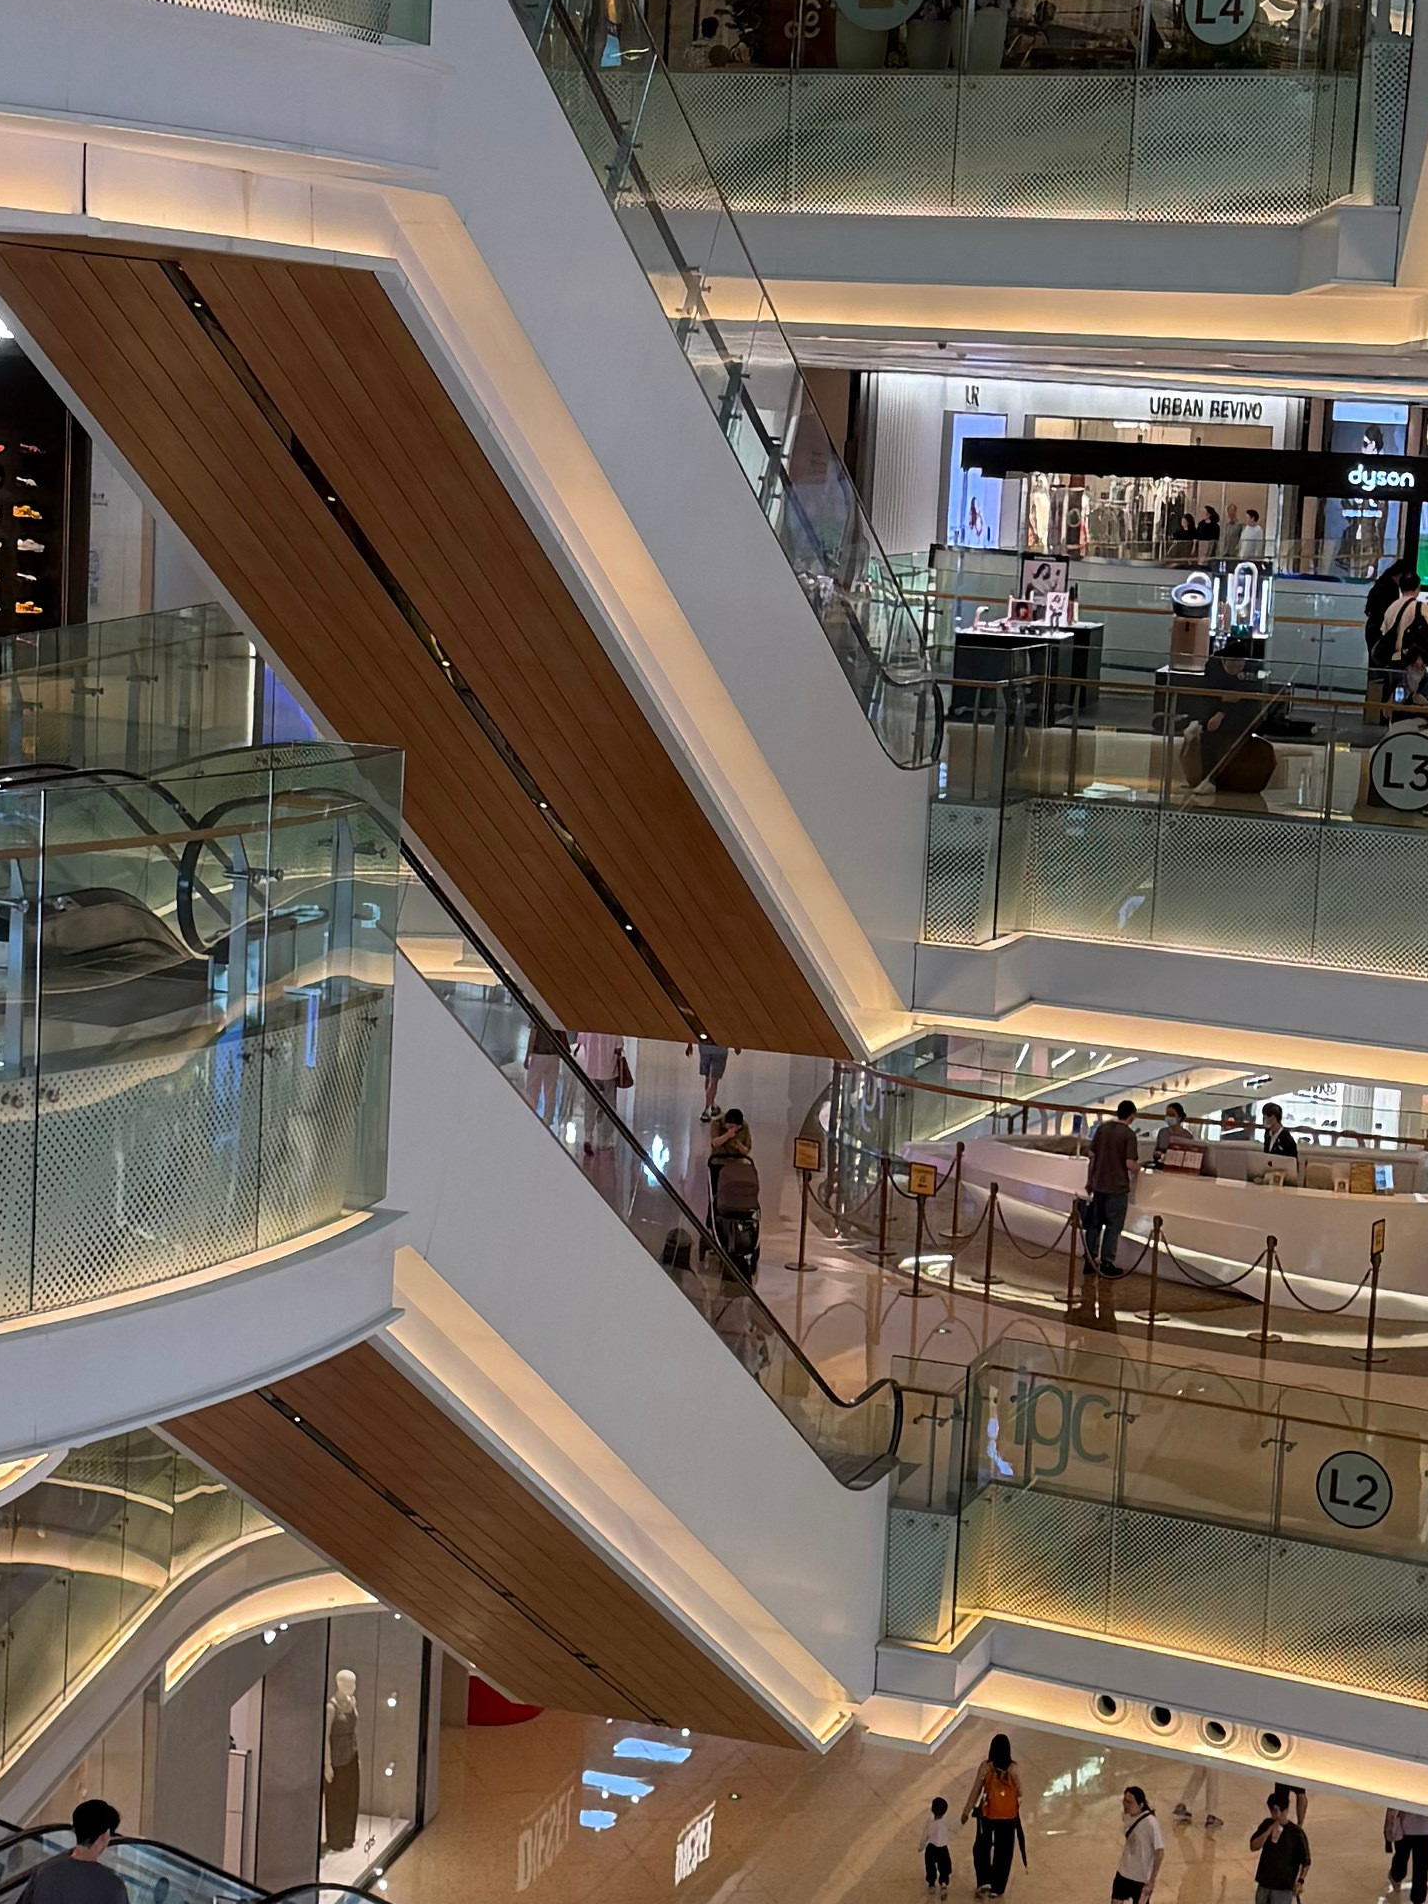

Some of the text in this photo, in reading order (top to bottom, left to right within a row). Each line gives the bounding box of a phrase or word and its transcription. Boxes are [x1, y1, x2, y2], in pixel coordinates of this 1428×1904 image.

[1149, 396, 1263, 420] URBAN REVIVO
[1348, 463, 1415, 492] dyson
[1012, 1364, 1110, 1476] igc
[1328, 1466, 1379, 1513] L2
